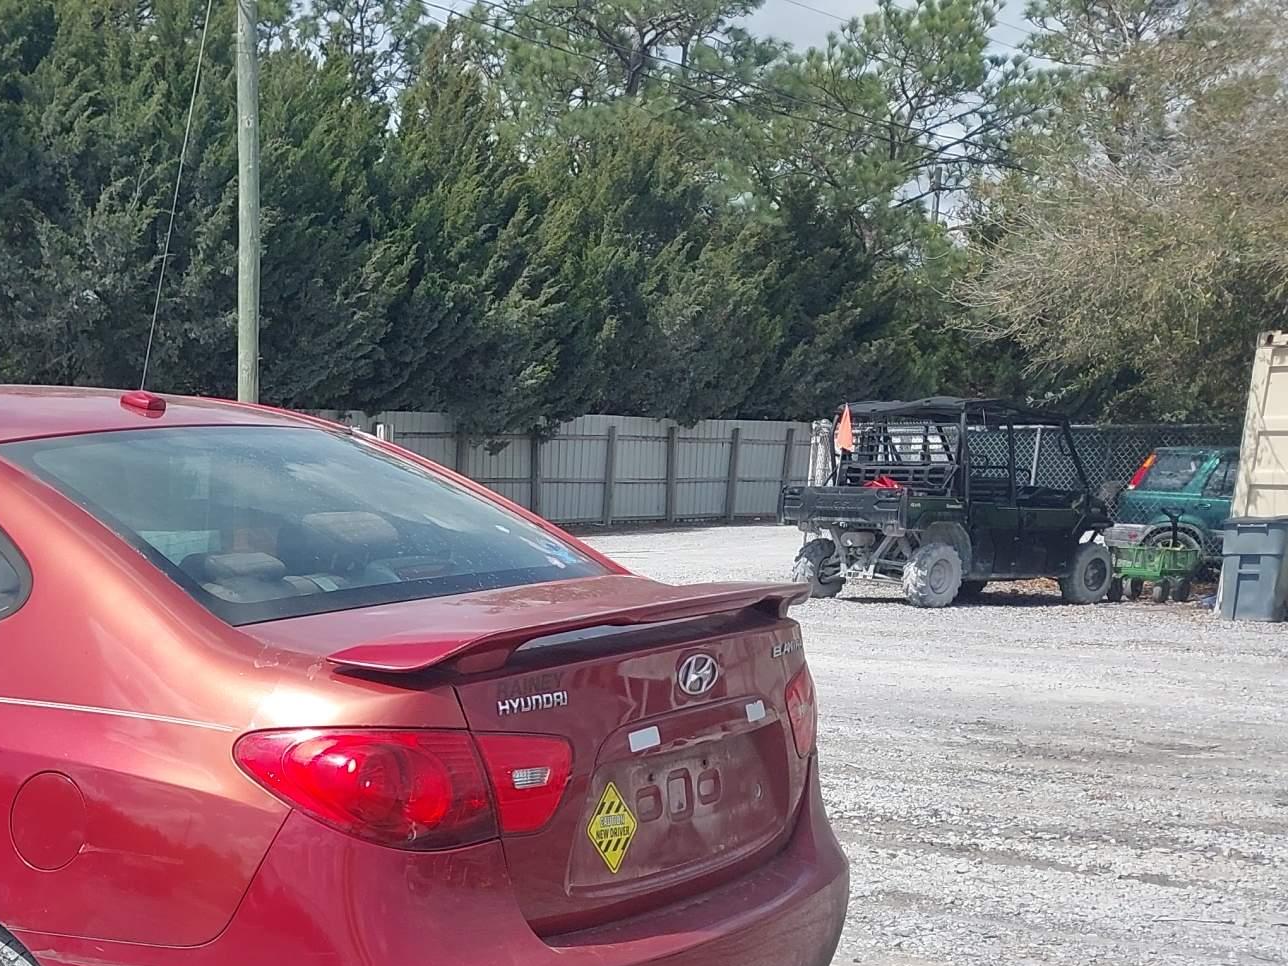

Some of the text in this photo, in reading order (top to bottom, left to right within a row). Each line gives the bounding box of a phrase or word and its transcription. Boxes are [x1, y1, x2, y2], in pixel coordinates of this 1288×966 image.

[497, 690, 568, 716] HYUNDAI
[600, 814, 625, 828] CAUTION
[596, 826, 630, 840] NEW DRIVER
